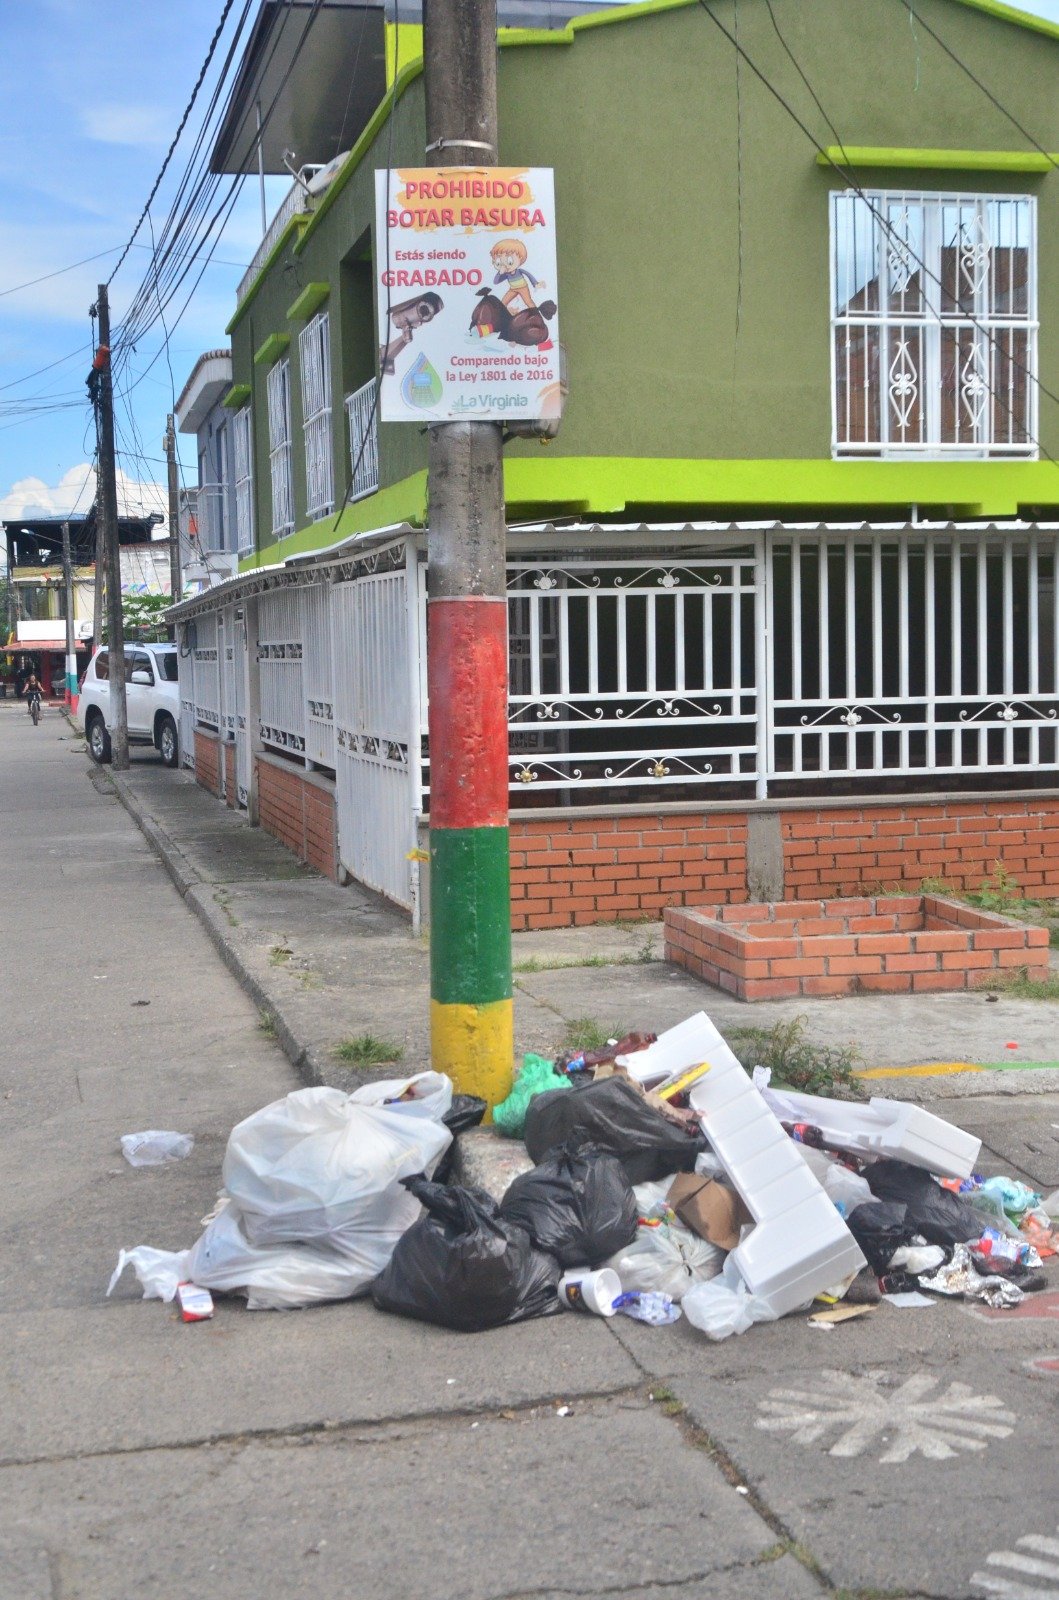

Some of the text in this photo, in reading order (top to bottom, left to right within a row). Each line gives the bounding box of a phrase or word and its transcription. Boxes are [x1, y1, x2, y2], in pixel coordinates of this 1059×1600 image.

[405, 180, 524, 199] PROHIBIDO
[387, 208, 546, 228] BOTAR BASURA
[395, 249, 466, 261] Estás siendo
[381, 269, 483, 287] GRABADO
[450, 354, 548, 367] Comparendo bajo
[446, 370, 554, 384] la Ley 1801 de 2016
[479, 394, 528, 410] Virginia
